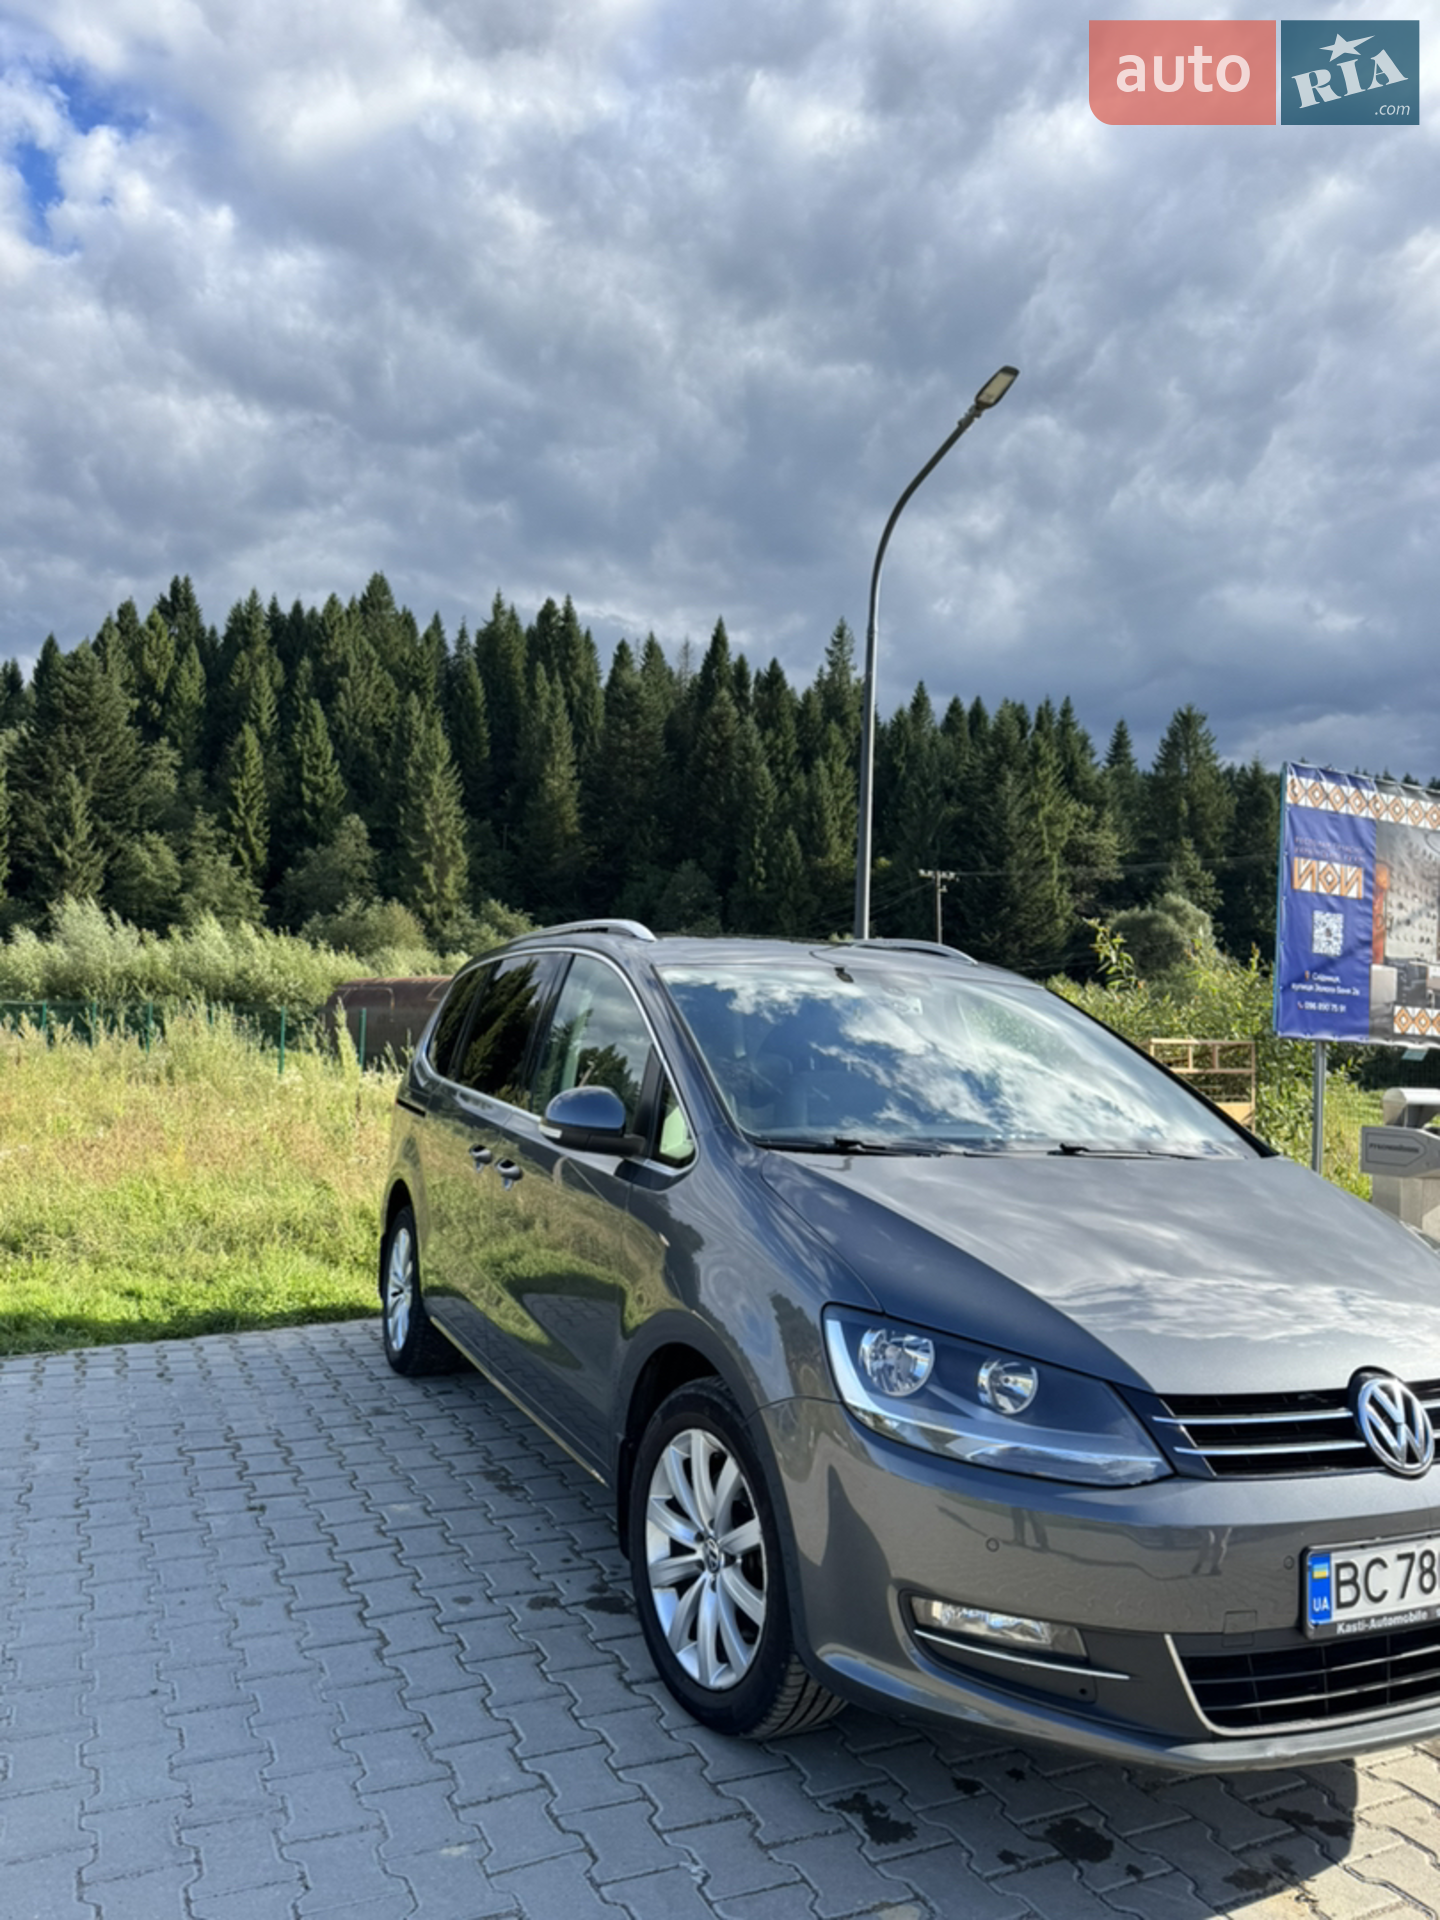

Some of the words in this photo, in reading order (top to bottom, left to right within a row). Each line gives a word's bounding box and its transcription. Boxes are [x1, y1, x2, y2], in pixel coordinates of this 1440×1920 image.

[1335, 1557, 1388, 1609] BC
[1396, 1549, 1440, 1600] 78
[1312, 1596, 1330, 1612] UA
[1336, 1610, 1428, 1635] Kasti-Automobile
